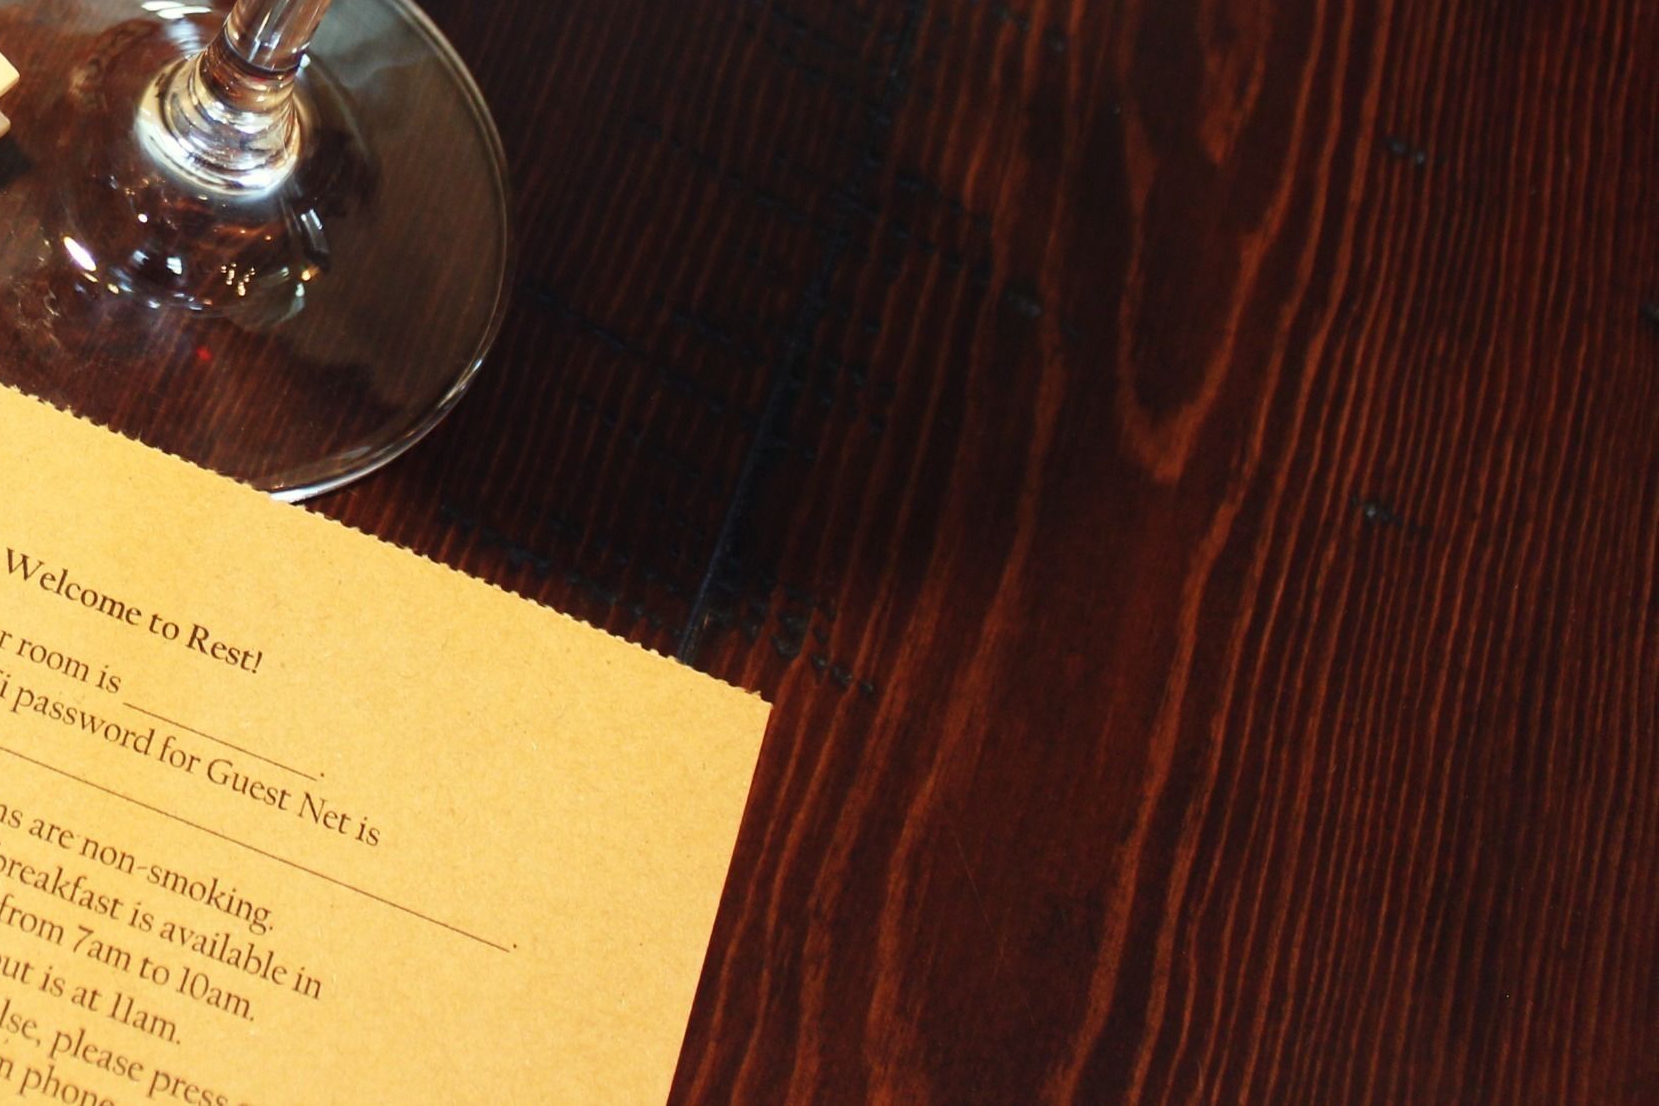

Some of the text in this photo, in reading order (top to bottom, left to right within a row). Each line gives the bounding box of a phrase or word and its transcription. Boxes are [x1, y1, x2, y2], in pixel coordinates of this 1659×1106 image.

[4, 546, 264, 675] Welcome to Rest!
[17, 638, 90, 682] room
[97, 664, 123, 695] is
[10, 686, 156, 756] password
[158, 735, 201, 774] for
[206, 757, 292, 812] Guest
[297, 791, 352, 836] Net
[354, 816, 381, 847] is
[28, 816, 76, 850] are
[79, 836, 275, 936] non-smoking.
[72, 924, 133, 972] 7am
[139, 955, 170, 986] to
[176, 965, 256, 1023] 10am.
[128, 901, 154, 931] is
[159, 922, 289, 986] available
[292, 967, 323, 1001] in
[38, 965, 67, 998] is
[70, 986, 102, 1012] at
[107, 992, 183, 1046] 11am.
[47, 1028, 145, 1082] please
[146, 1068, 229, 1106] press
